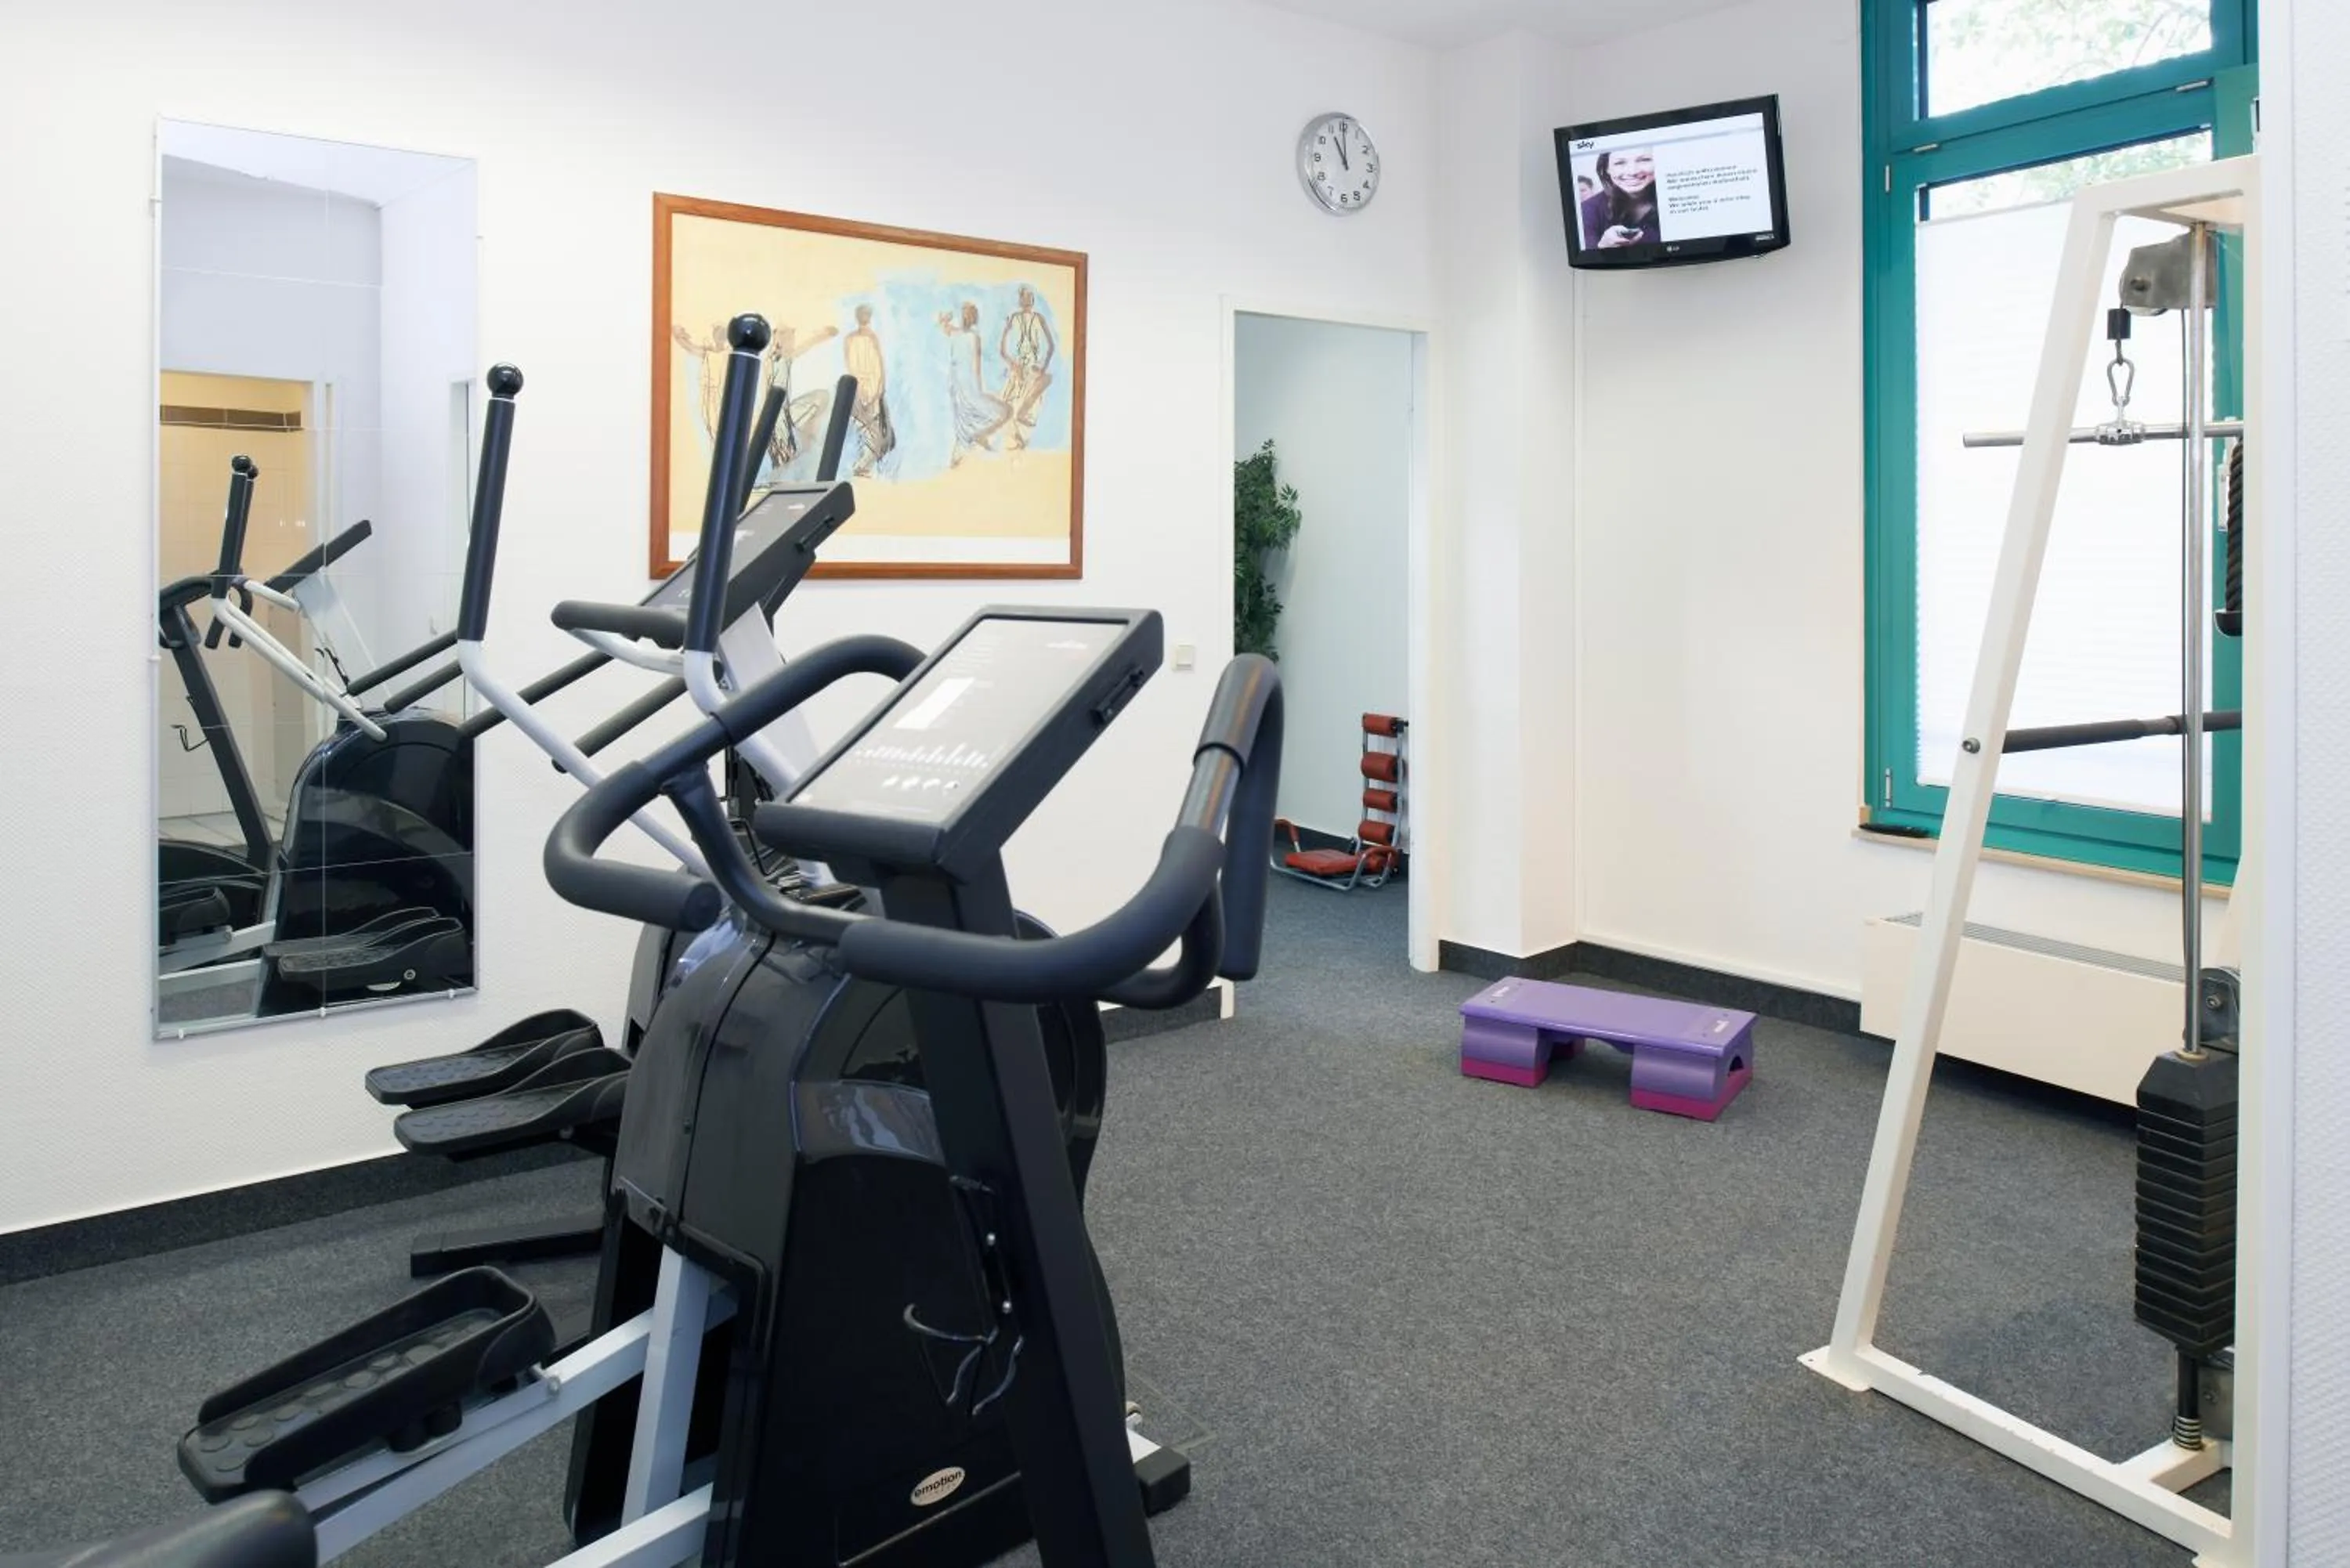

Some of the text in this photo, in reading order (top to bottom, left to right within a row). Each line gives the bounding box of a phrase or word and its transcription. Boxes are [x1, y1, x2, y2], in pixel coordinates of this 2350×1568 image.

[1577, 140, 1594, 149] sky
[1340, 193, 1348, 203] 6
[914, 1471, 962, 1498] emotion
